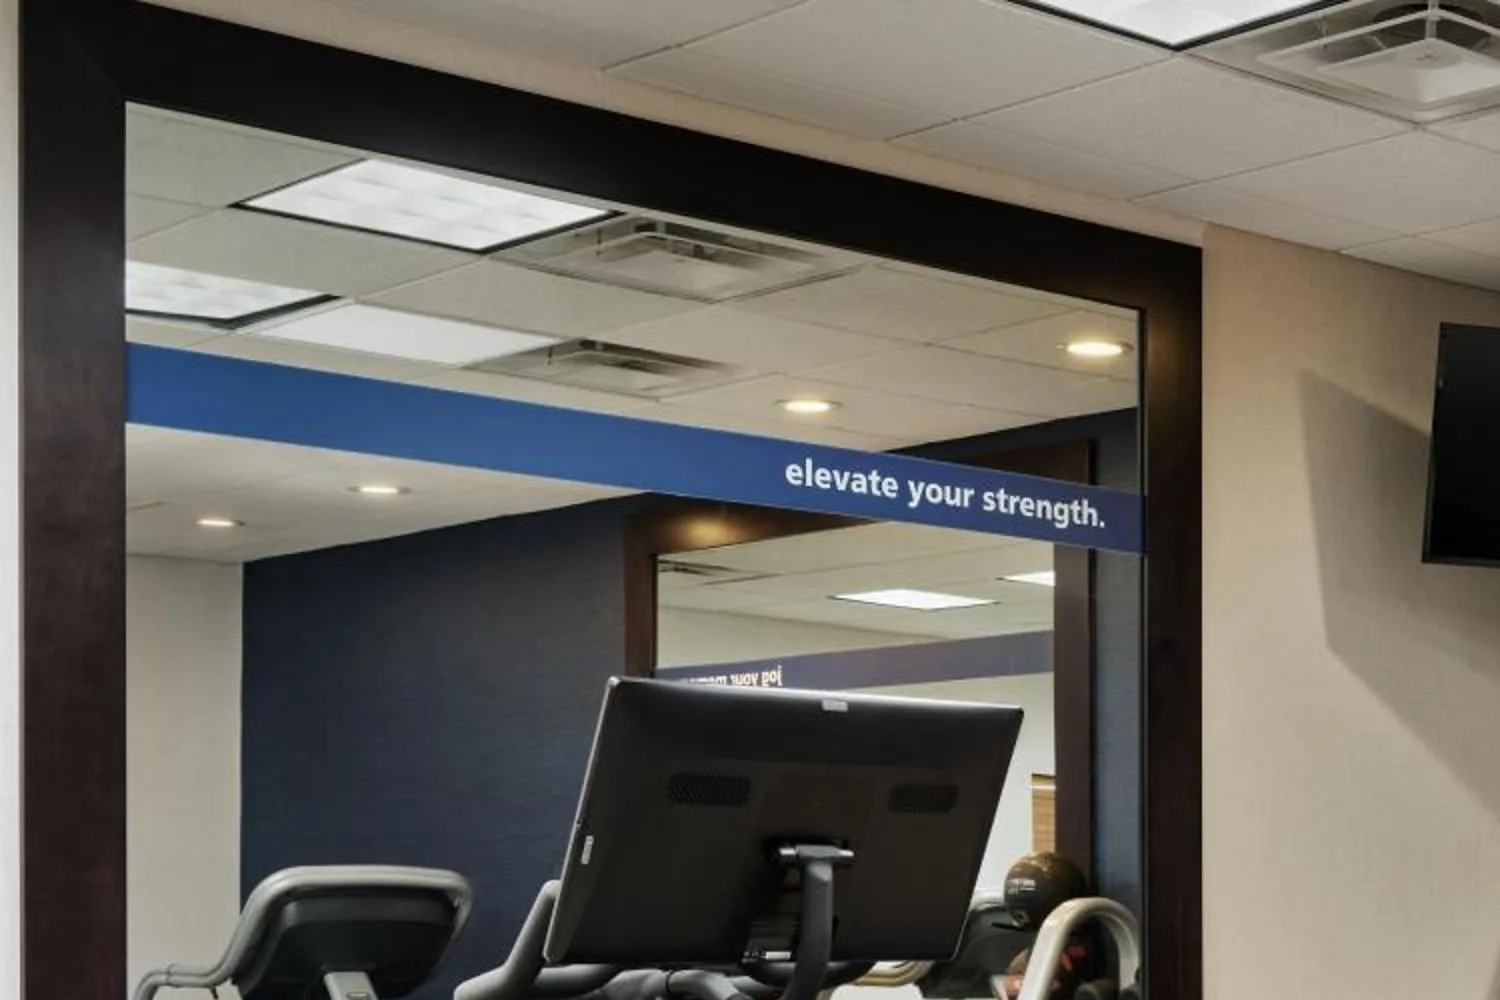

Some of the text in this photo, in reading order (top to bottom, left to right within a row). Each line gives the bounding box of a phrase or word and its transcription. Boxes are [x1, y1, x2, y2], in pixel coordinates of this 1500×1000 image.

[785, 457, 1105, 529] elevate your strength.
